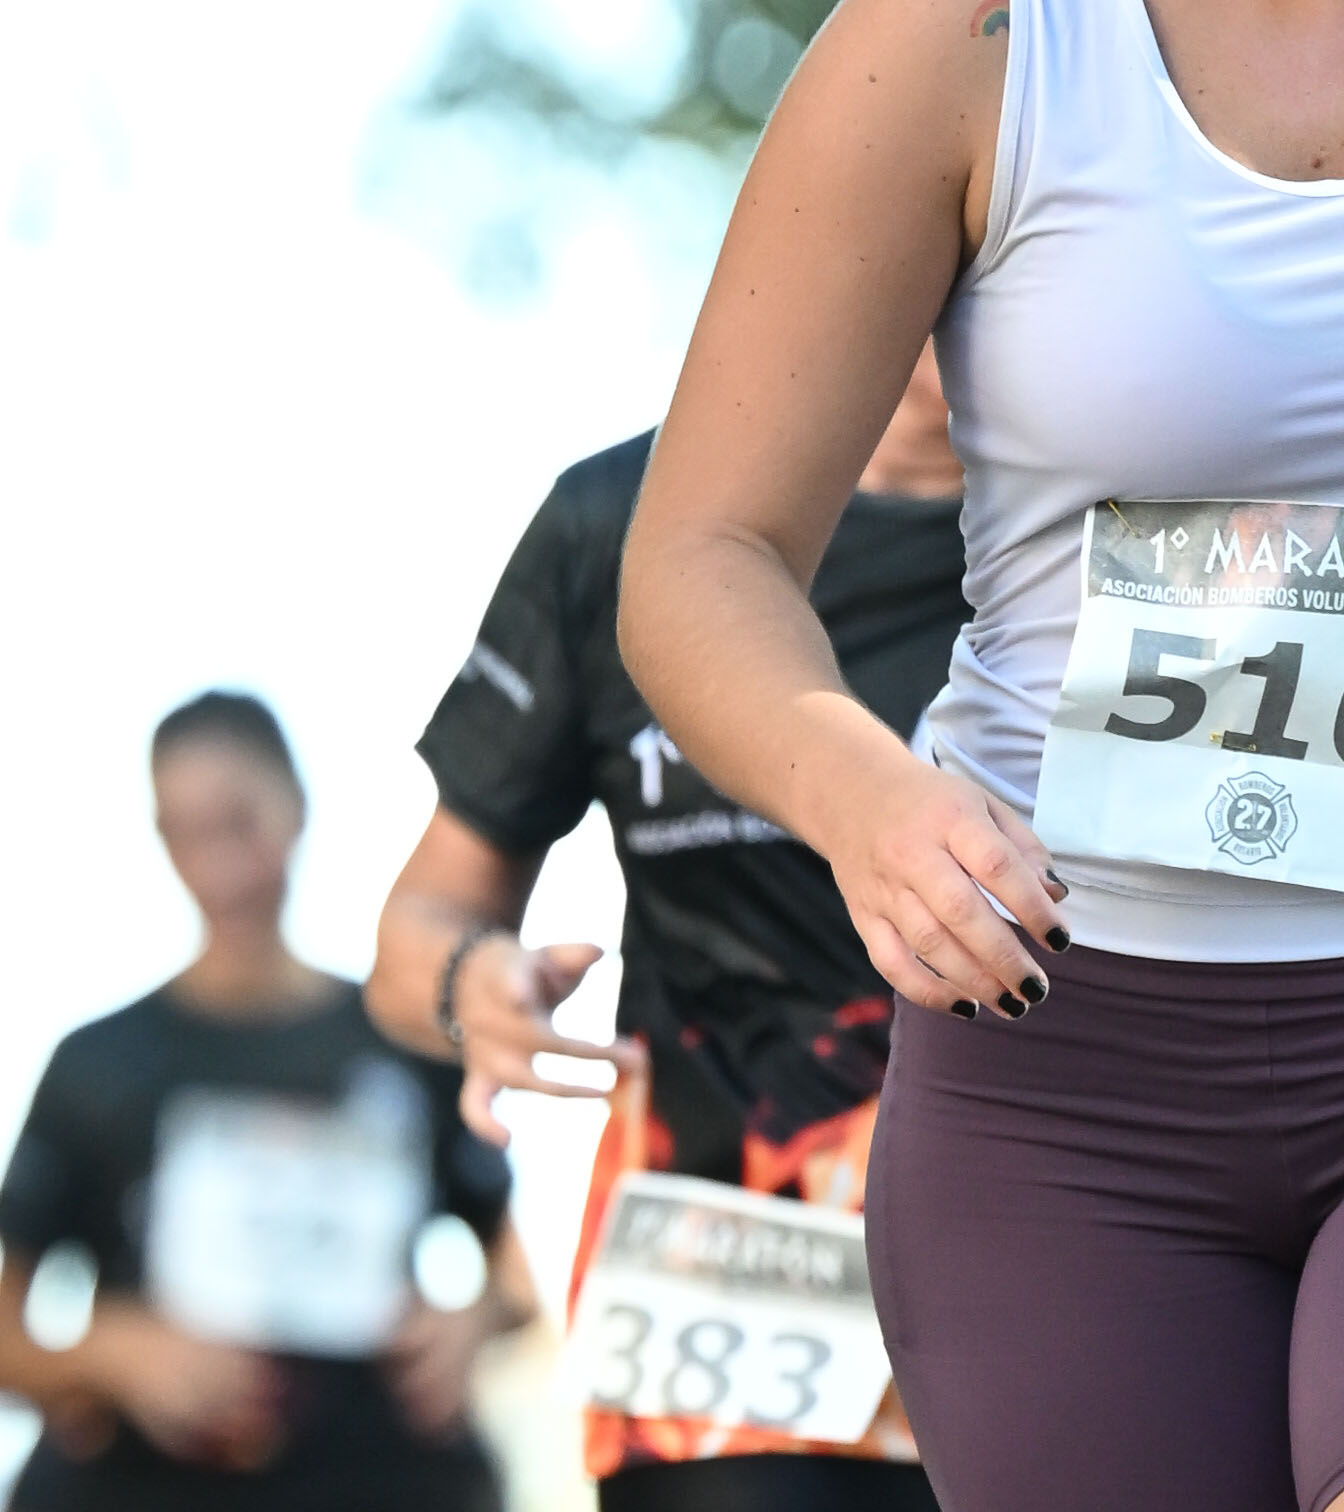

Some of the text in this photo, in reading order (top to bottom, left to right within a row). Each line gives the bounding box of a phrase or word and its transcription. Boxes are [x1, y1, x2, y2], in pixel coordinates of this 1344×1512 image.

[1101, 577, 1204, 606] ASOCIACIÓN
[1207, 584, 1298, 608] BOMBEROS
[1104, 628, 1344, 761] 51
[1233, 797, 1272, 831] 27
[591, 1303, 833, 1430] 383
